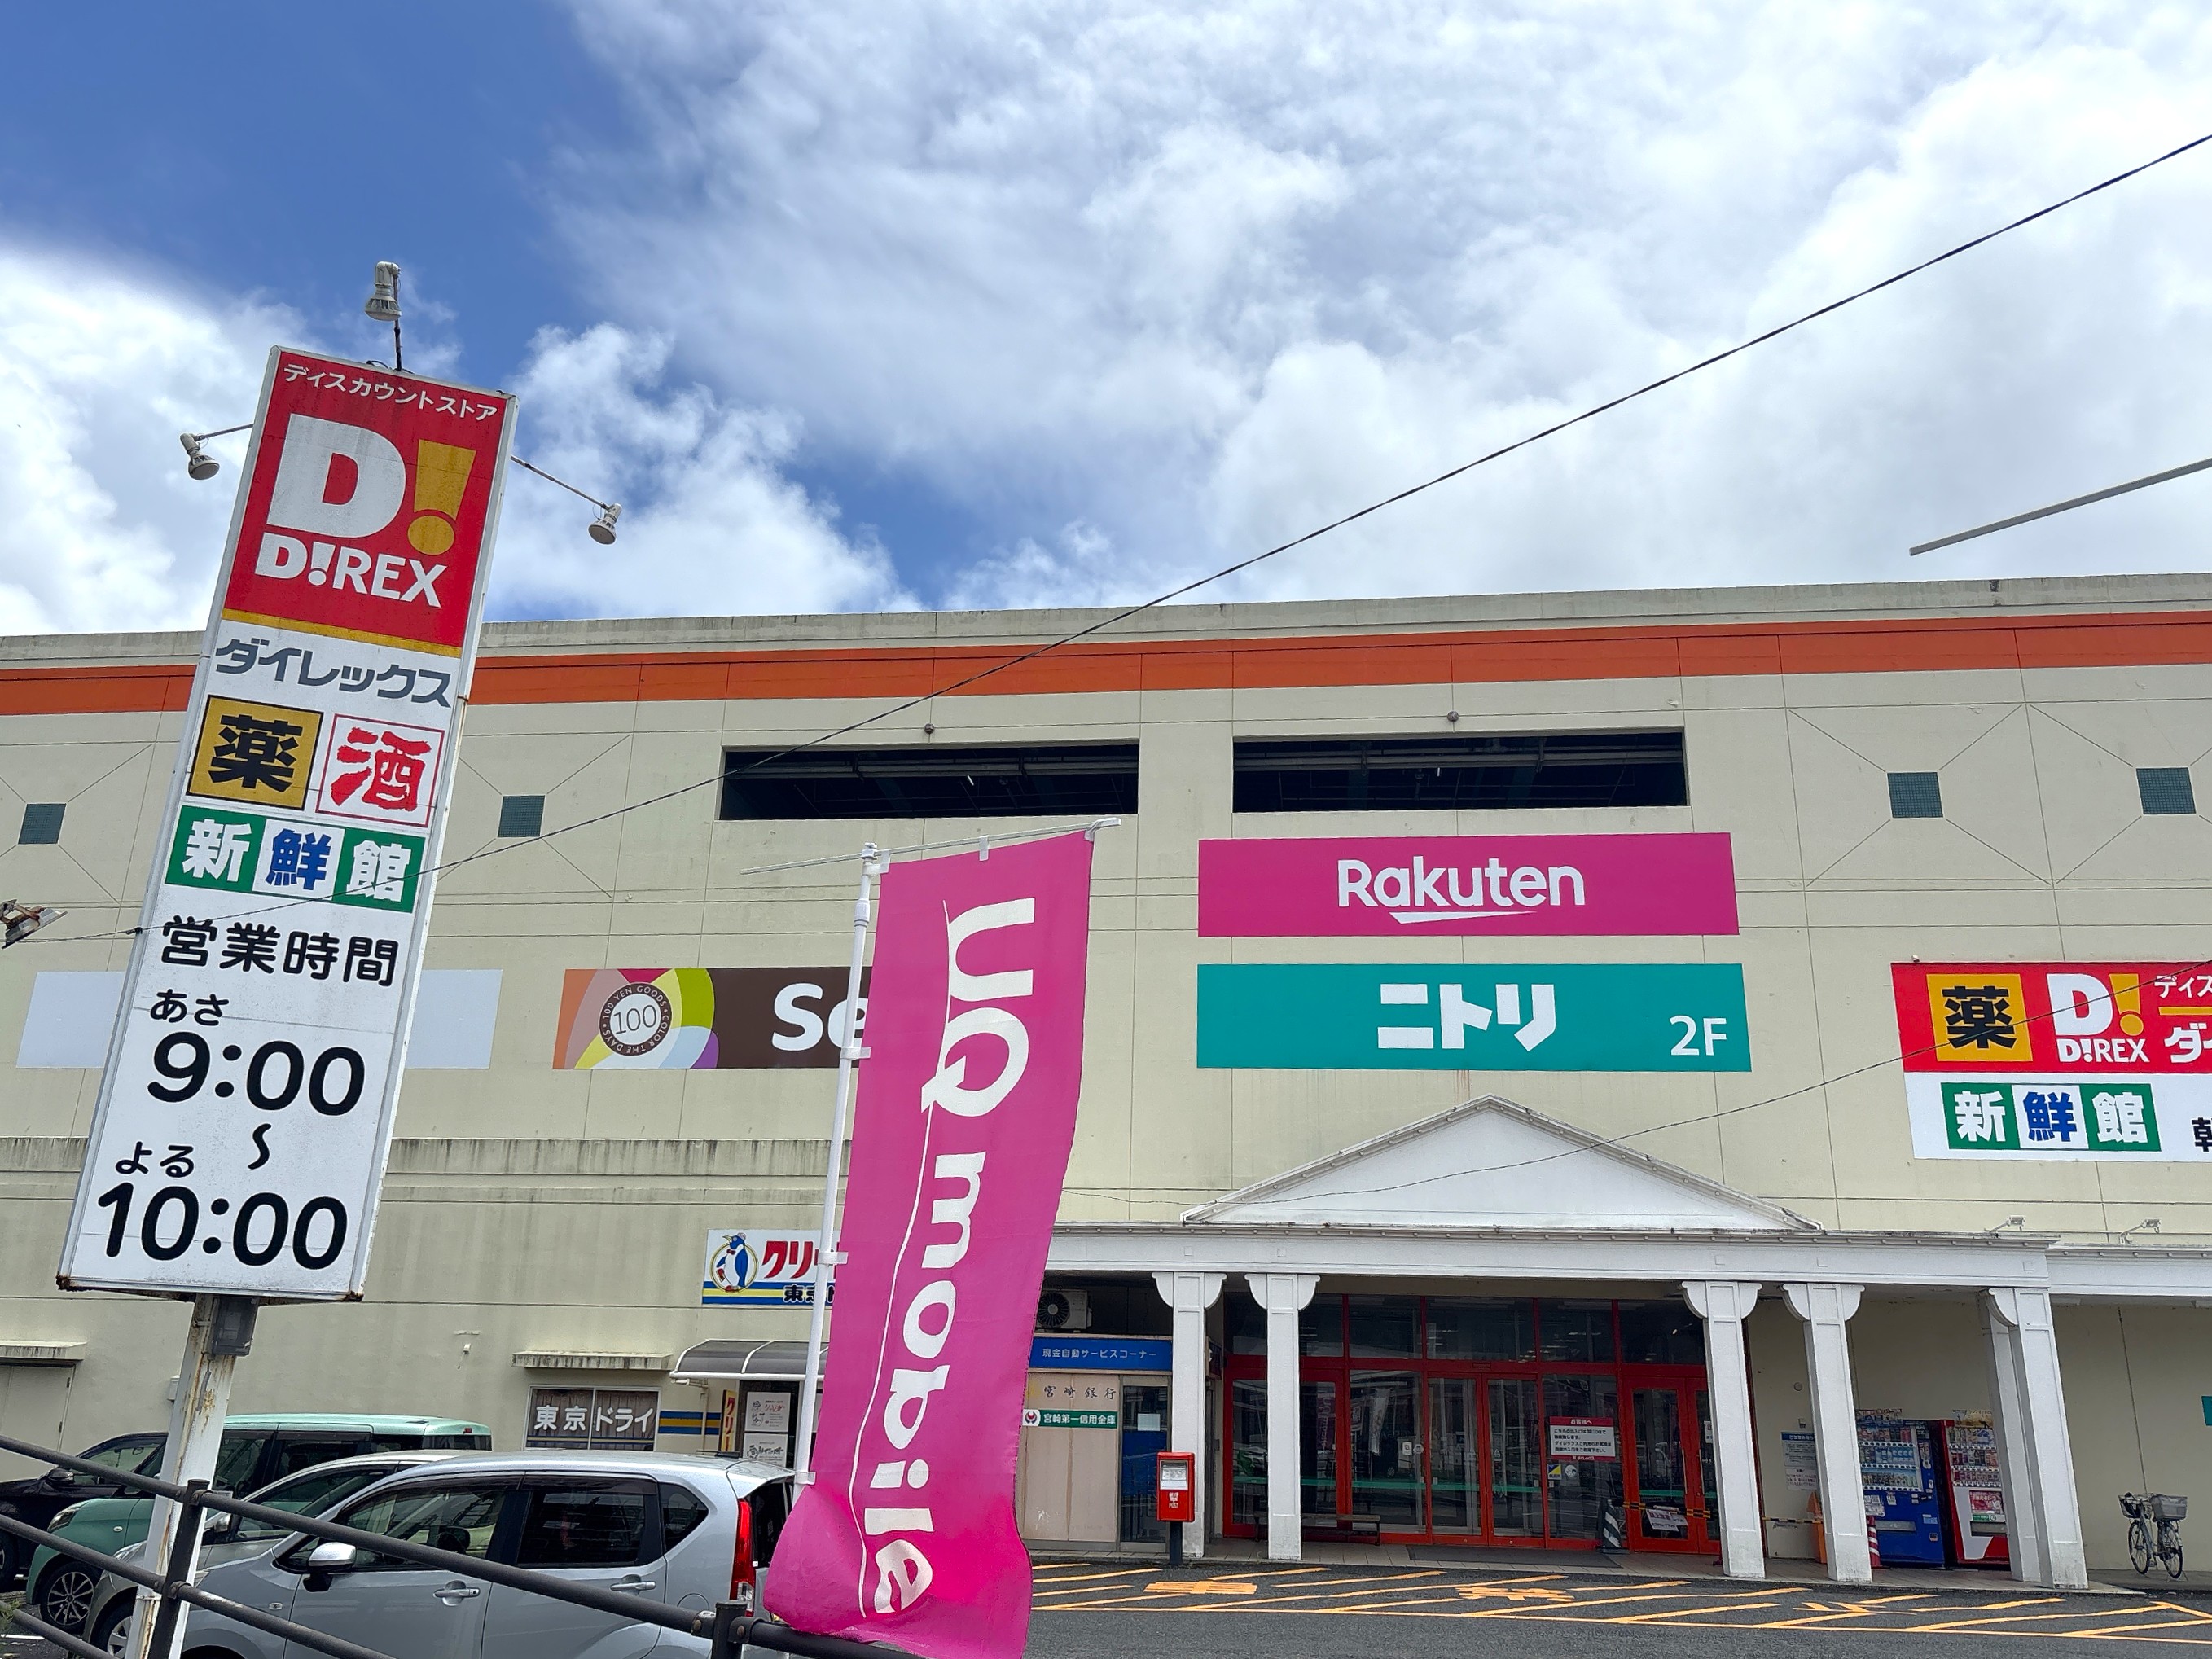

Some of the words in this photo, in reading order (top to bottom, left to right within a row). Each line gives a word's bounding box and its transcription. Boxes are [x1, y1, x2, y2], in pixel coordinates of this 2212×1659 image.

[284, 364, 498, 421] ディスカウントストア
[215, 639, 452, 709] ダイレックス
[208, 714, 304, 793] 薬
[330, 726, 432, 812] 酒
[182, 818, 412, 902] 新鮮館
[1338, 856, 1585, 907] Rakuten
[161, 915, 398, 987] 営業時間
[150, 989, 230, 1026] あさ
[603, 1003, 614, 1019] 100
[614, 987, 633, 1001] YEN
[636, 985, 667, 1007] GOODS
[613, 1004, 657, 1035] 100
[647, 1015, 669, 1047] COLOR
[1378, 983, 1556, 1051] ニトリ
[1670, 1015, 1727, 1056] 2F
[1942, 985, 2017, 1048] 薬
[603, 1029, 624, 1051] DAYS
[626, 1045, 647, 1054] THE
[2164, 1023, 2212, 1064] ダ
[147, 1031, 366, 1117] 9:00
[1955, 1091, 2148, 1143] 新鮮館
[116, 1141, 195, 1178] よる
[97, 1182, 348, 1271] 10:00
[1042, 1348, 1156, 1359] 現金自動サービスコーナー
[864, 1152, 986, 1614] mobile
[533, 1404, 653, 1433] 東京ドライ
[1043, 1413, 1116, 1425] 宮崎第一信用金庫
